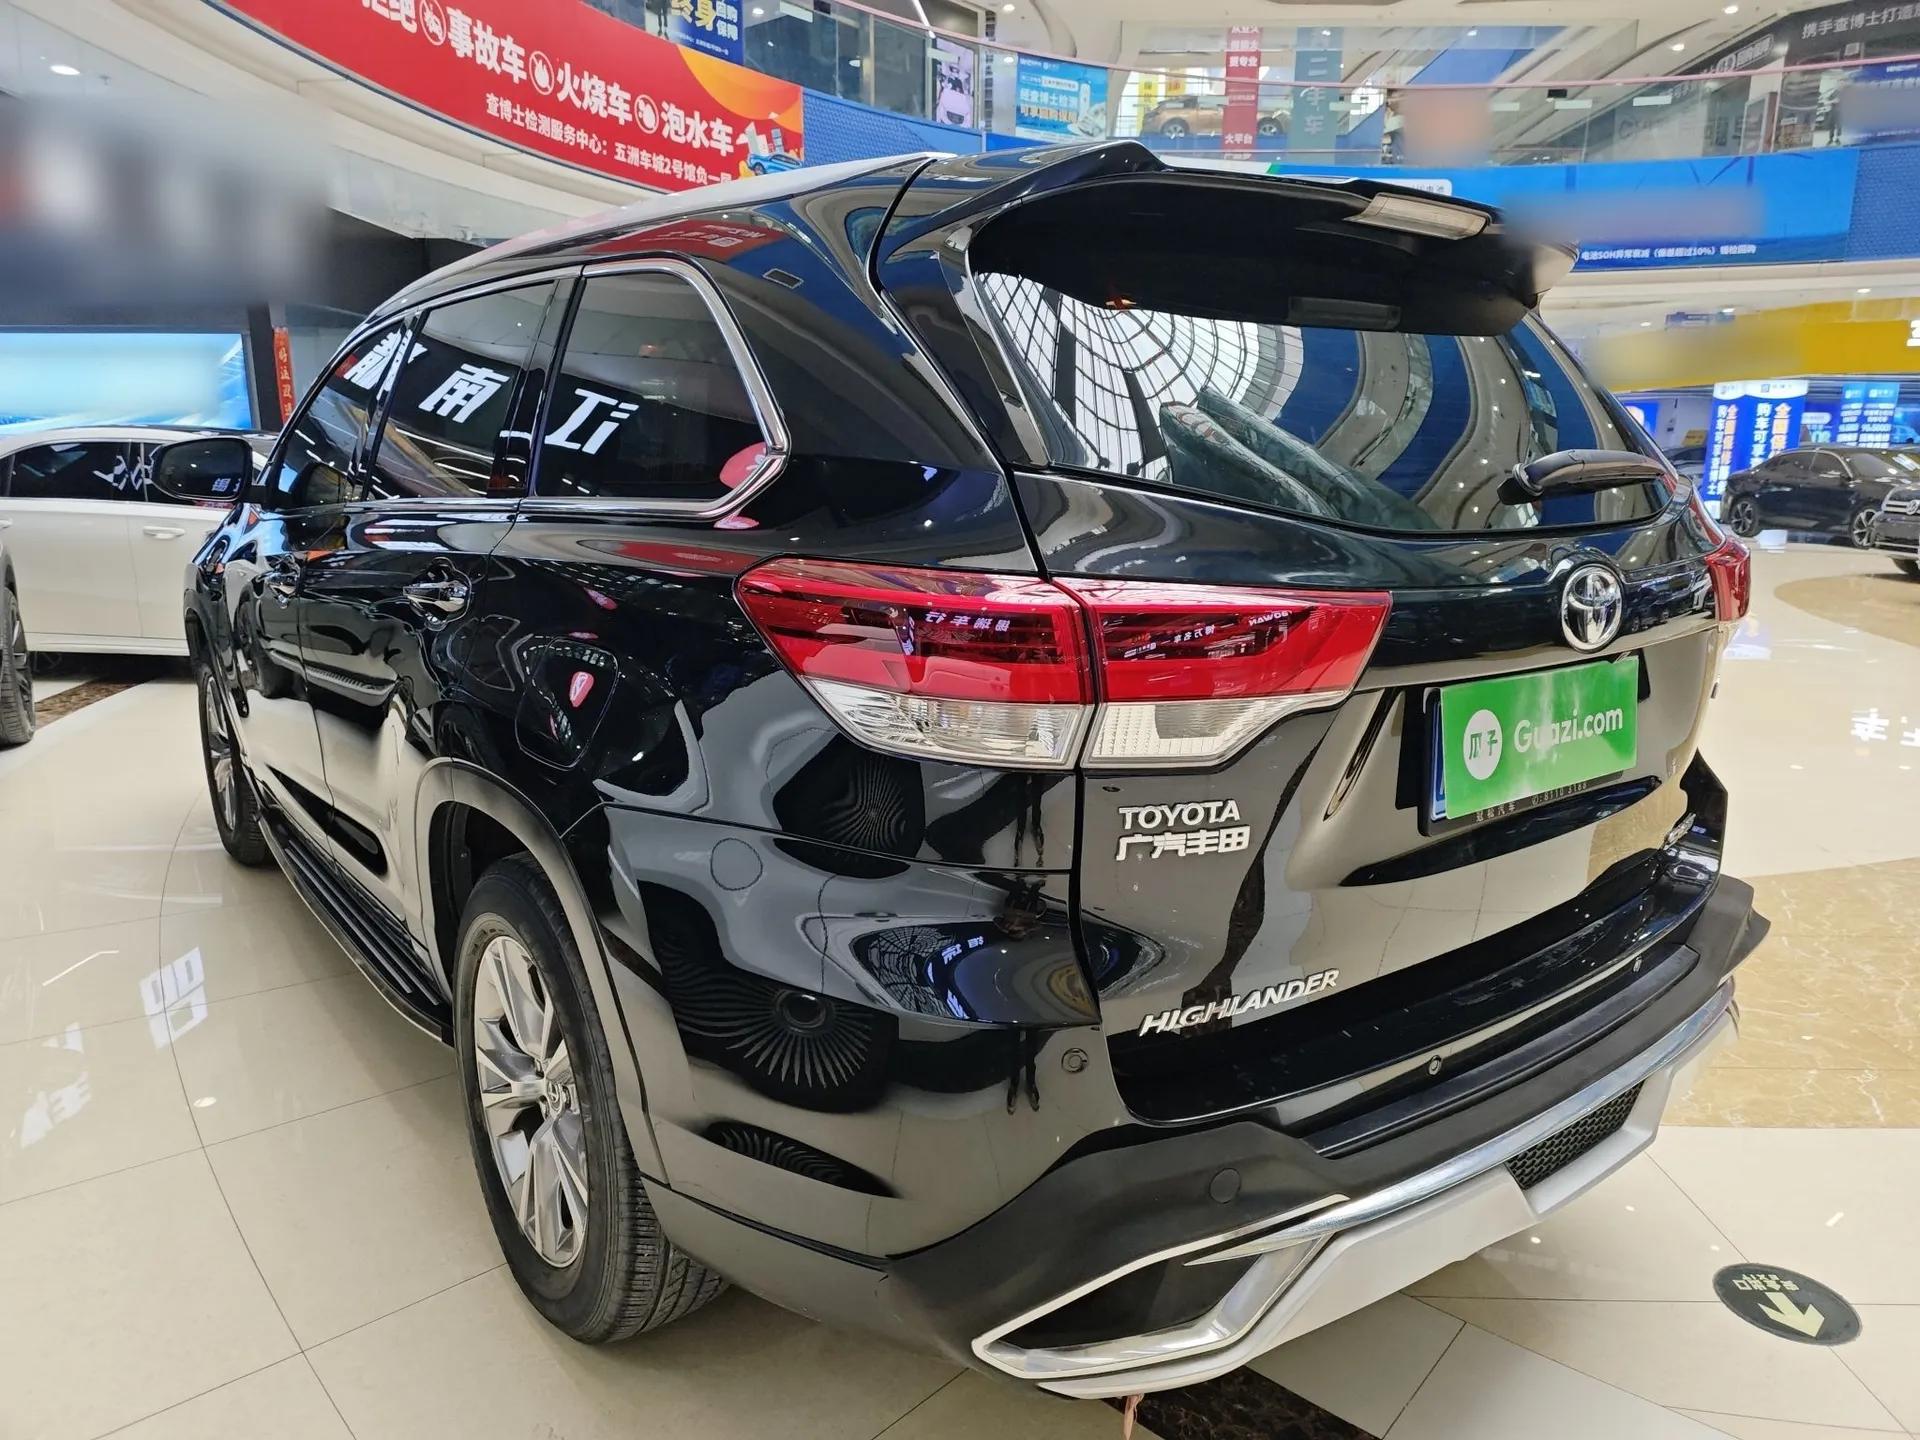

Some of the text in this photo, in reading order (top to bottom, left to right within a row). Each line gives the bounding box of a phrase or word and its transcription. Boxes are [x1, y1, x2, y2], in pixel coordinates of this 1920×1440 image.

[446, 6, 527, 85] 事故车
[556, 62, 633, 126] 火烧车
[660, 100, 735, 157] 泡水车
[1224, 133, 1253, 144] 大平台
[1469, 731, 1498, 760] 瓜子
[1514, 708, 1623, 753] Guazi.com
[1119, 799, 1240, 830] TOYOTA
[1116, 825, 1251, 862] 广汽丰田
[1139, 968, 1340, 1037] HIGHLANDER
